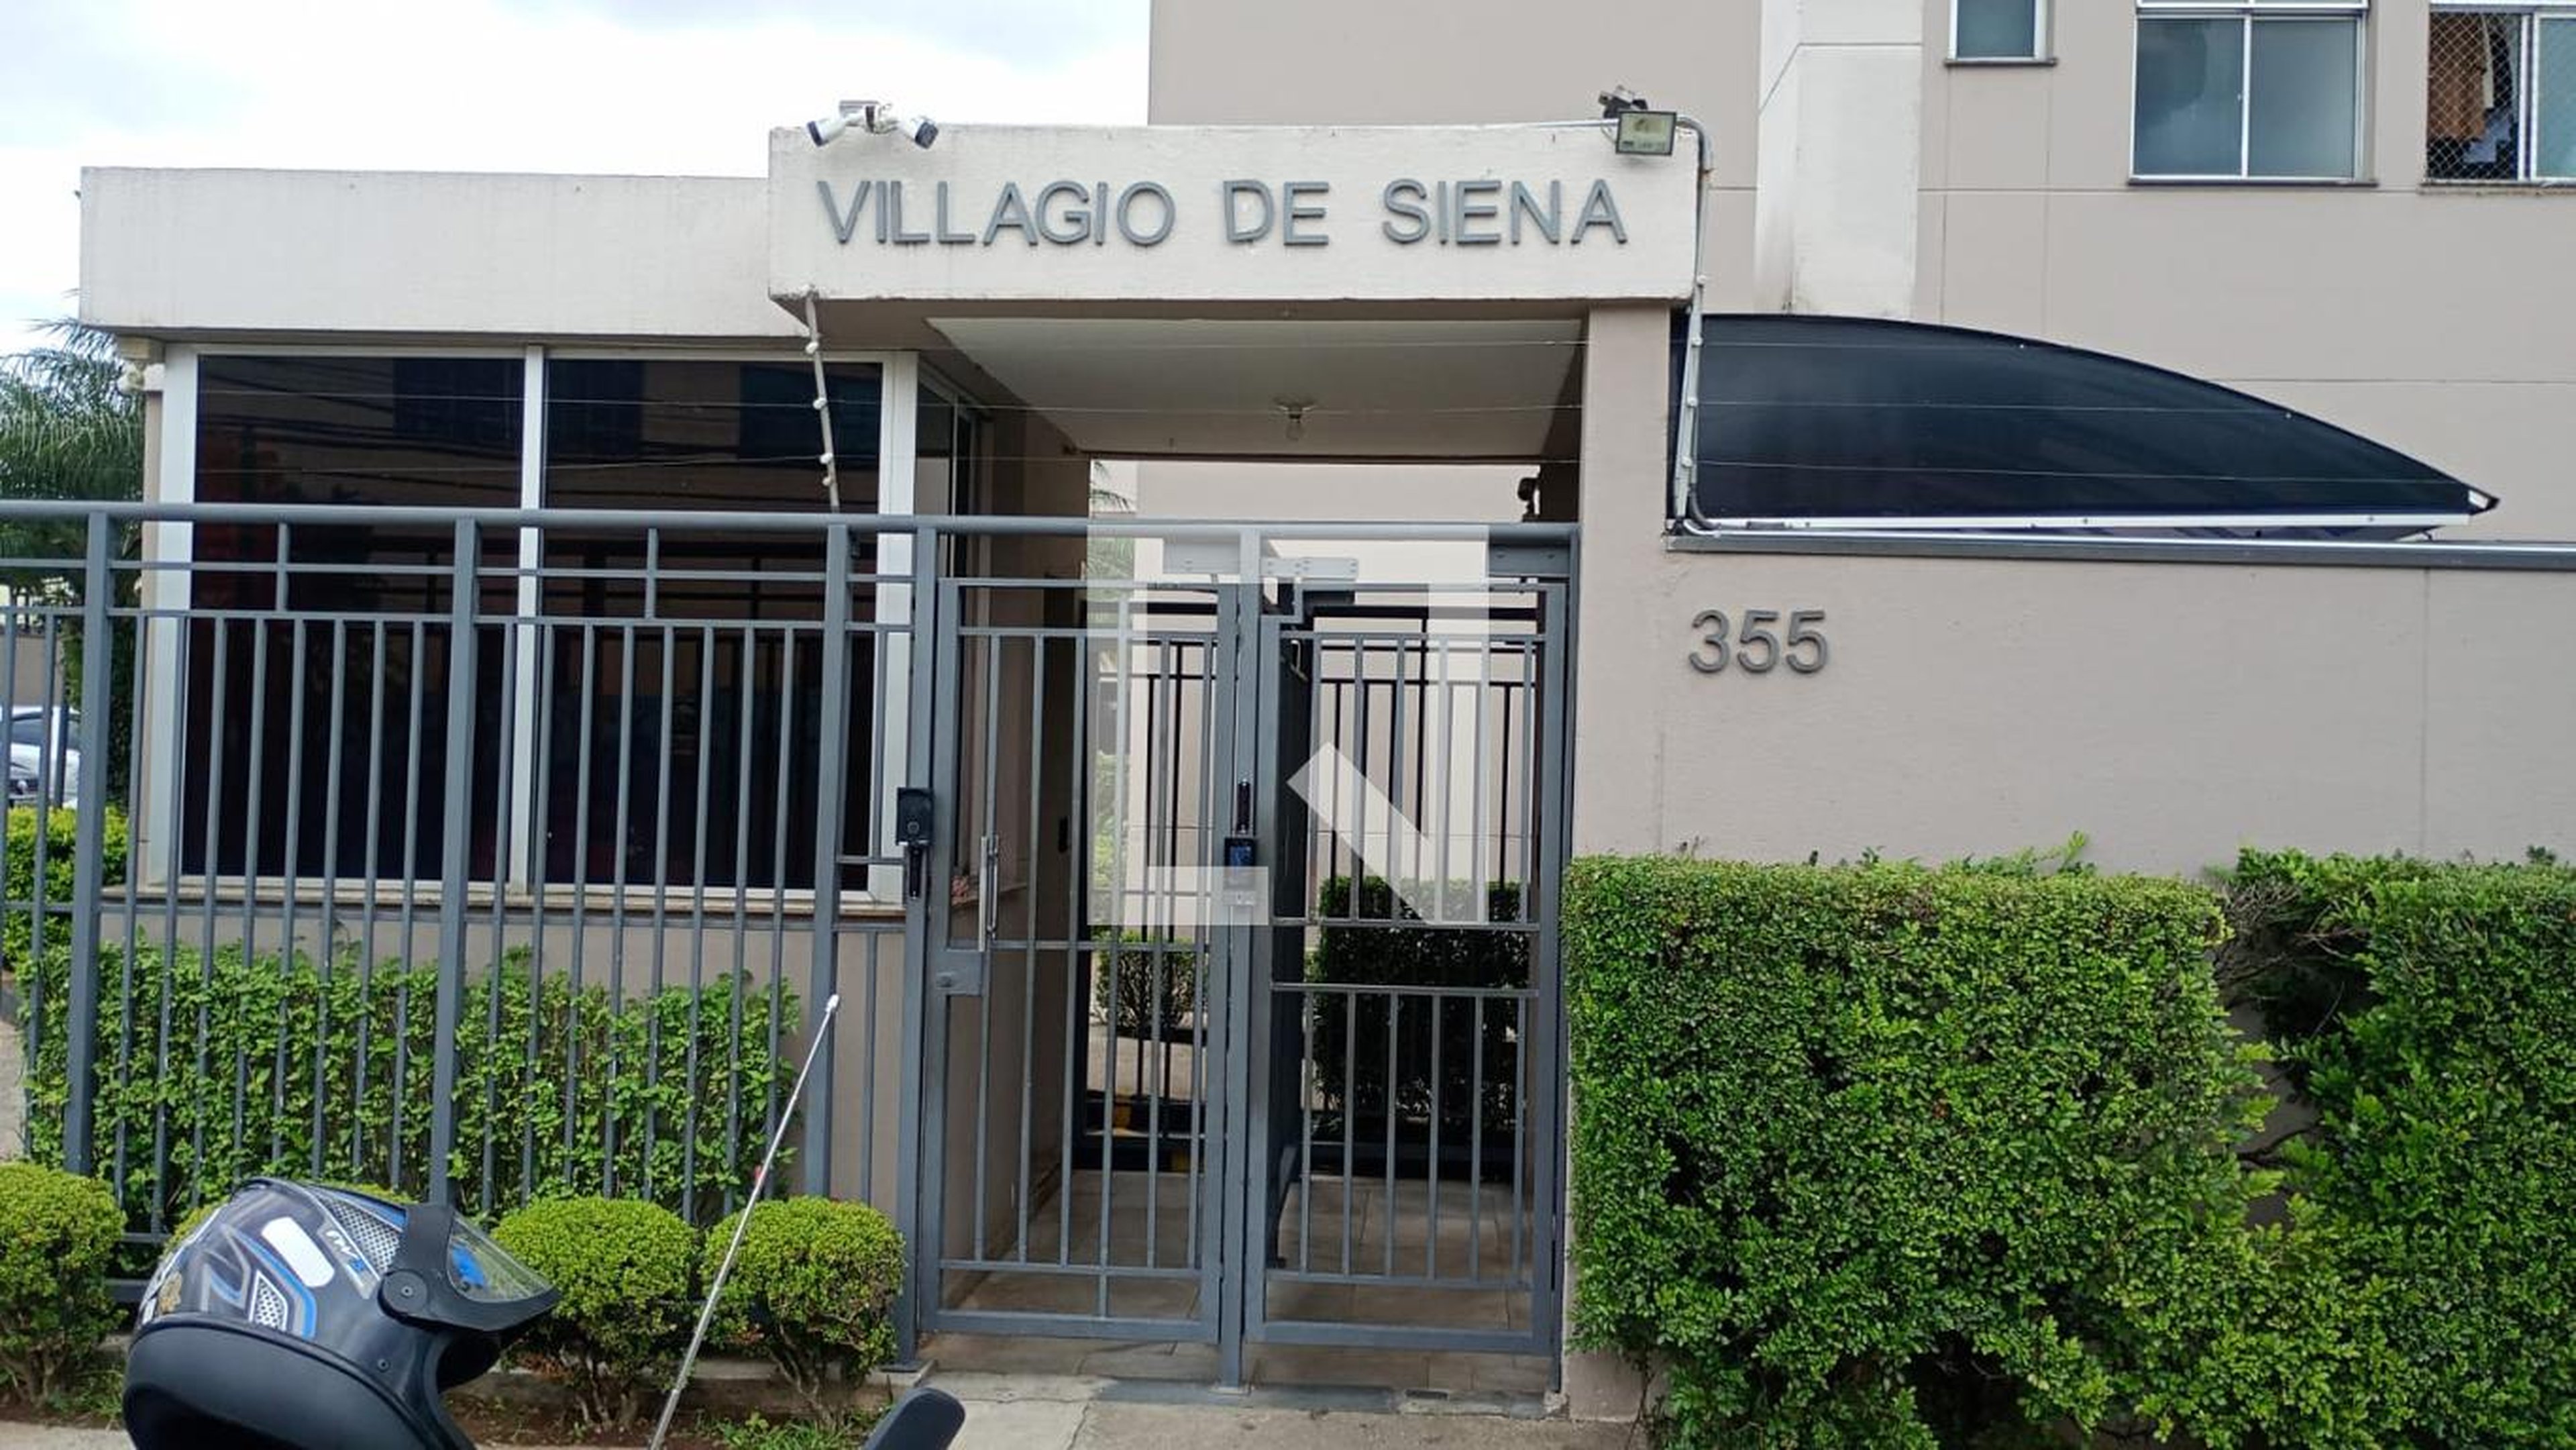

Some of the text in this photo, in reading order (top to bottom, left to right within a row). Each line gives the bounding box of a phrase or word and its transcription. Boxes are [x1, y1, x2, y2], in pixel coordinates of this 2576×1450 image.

[816, 178, 1629, 247] VILLAGIO DE SIENA
[1688, 609, 1828, 674] 355
